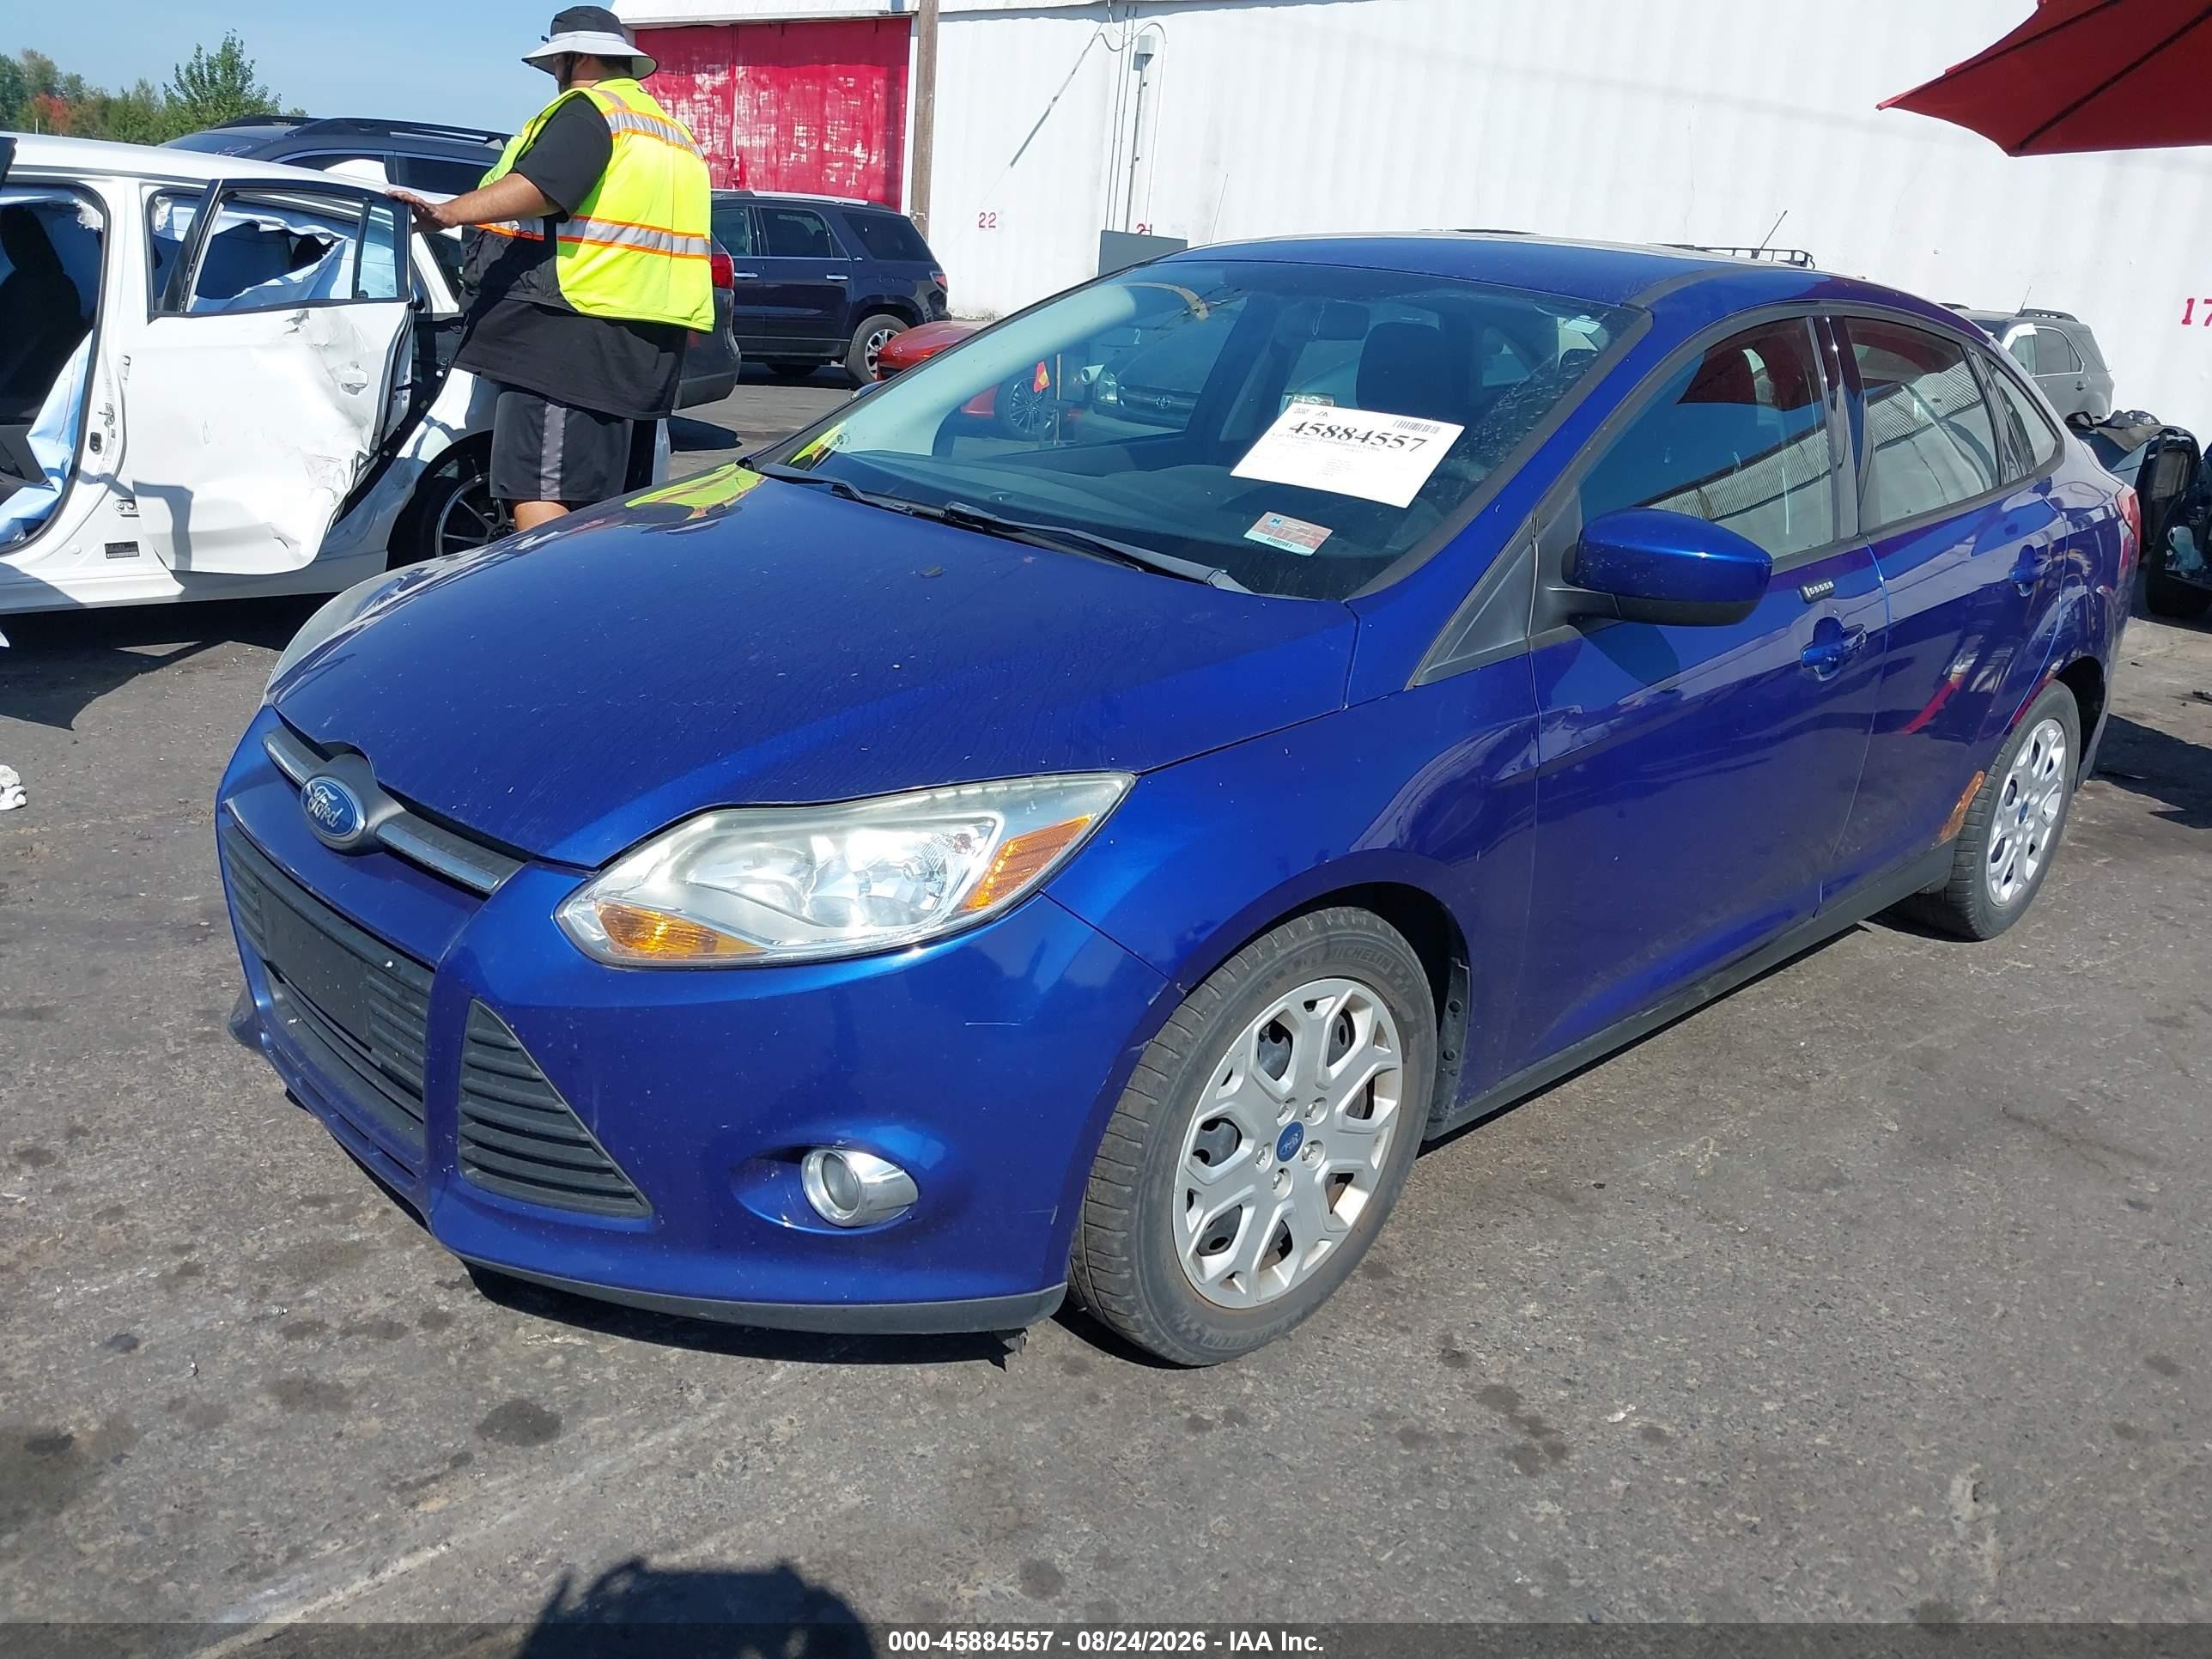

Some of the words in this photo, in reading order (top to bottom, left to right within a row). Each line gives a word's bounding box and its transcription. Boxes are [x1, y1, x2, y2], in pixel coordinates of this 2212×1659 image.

[978, 212, 997, 228] 22
[1289, 421, 1429, 452] 45884557
[307, 785, 343, 828] Ford
